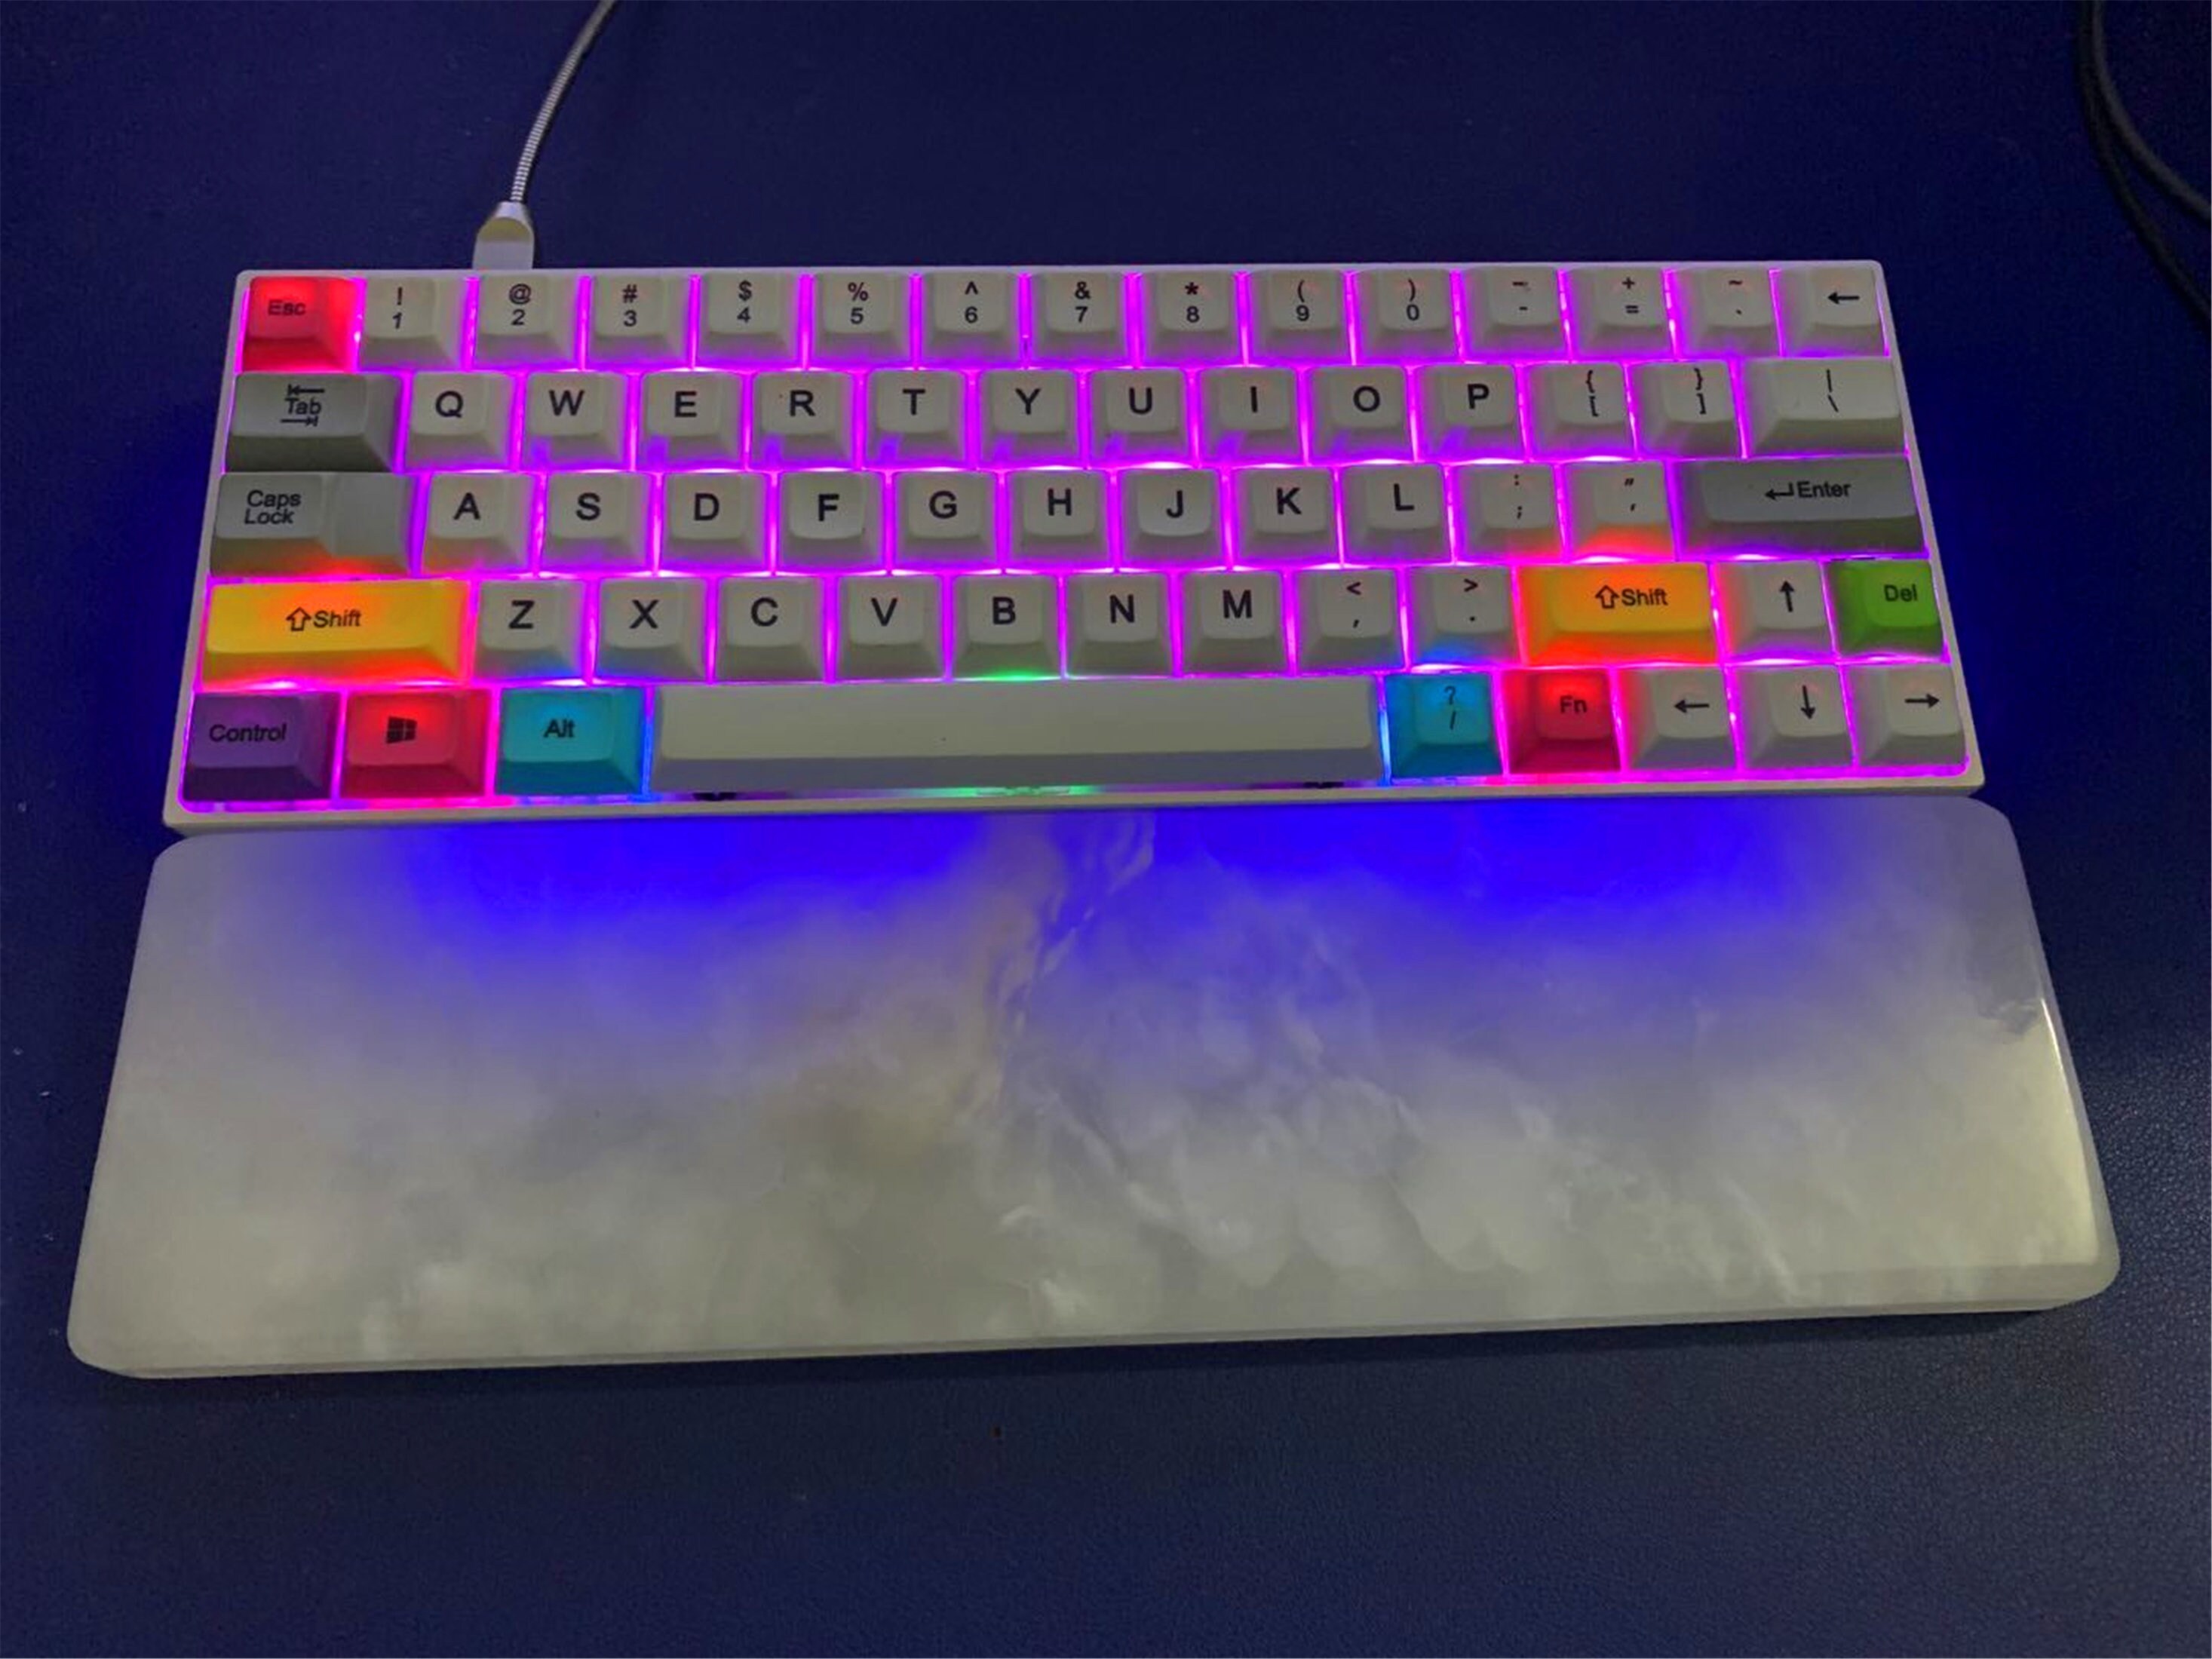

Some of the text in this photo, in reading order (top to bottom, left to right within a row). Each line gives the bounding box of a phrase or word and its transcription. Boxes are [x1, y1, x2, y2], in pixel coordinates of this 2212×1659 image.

[509, 284, 531, 305] @
[622, 284, 637, 303] #
[738, 280, 752, 302] $
[848, 282, 868, 301] %
[1075, 281, 1090, 299] &
[1297, 280, 1305, 303] (
[1408, 279, 1416, 302] )
[1621, 277, 1635, 290] +
[268, 299, 305, 316] Esc
[397, 287, 403, 306] !
[393, 312, 402, 329] 1
[511, 309, 525, 325] 2
[624, 310, 637, 327] 3
[738, 308, 750, 322] 4
[851, 308, 864, 324] 5
[965, 306, 977, 324] 6
[1075, 306, 1088, 322] 7
[1187, 306, 1199, 323] 8
[1296, 305, 1309, 321] 9
[1407, 305, 1419, 320] 0
[1625, 305, 1639, 314] =
[1585, 370, 1595, 394] {
[1694, 367, 1704, 391] }
[285, 397, 321, 416] Tab
[436, 391, 463, 418] Q
[549, 390, 584, 416] W
[675, 391, 697, 417] E
[790, 390, 815, 416] R
[903, 389, 925, 415] T
[1016, 388, 1040, 415] Y
[1129, 388, 1152, 414] U
[1251, 387, 1257, 412] I
[1354, 386, 1379, 412] O
[1468, 384, 1489, 409] P
[1589, 395, 1599, 417] [
[1696, 393, 1707, 415] ]
[1827, 394, 1839, 412] \
[1394, 484, 1414, 511] L
[1797, 481, 1851, 498] Enter
[246, 490, 300, 514] Caps
[454, 492, 480, 520] A
[576, 493, 600, 520] S
[695, 493, 719, 520] D
[818, 494, 839, 521] F
[929, 491, 956, 519] G
[1048, 489, 1071, 516] H
[1167, 490, 1183, 517] J
[1277, 488, 1301, 514] K
[244, 508, 294, 524] Lock
[1346, 581, 1361, 596] <
[1464, 578, 1478, 593] >
[1885, 584, 1917, 602] Del
[1223, 590, 1252, 618] M
[1622, 589, 1667, 606] Shift
[314, 610, 360, 628] Shift
[509, 600, 534, 629] Z
[630, 600, 658, 628] X
[751, 597, 778, 626] C
[871, 598, 897, 626] V
[993, 597, 1015, 624] B
[1110, 595, 1134, 623] N
[1443, 685, 1457, 706] ?
[1560, 695, 1587, 713] Fn
[544, 719, 575, 738] Alt
[1449, 710, 1457, 731] /
[210, 723, 287, 742] Control
